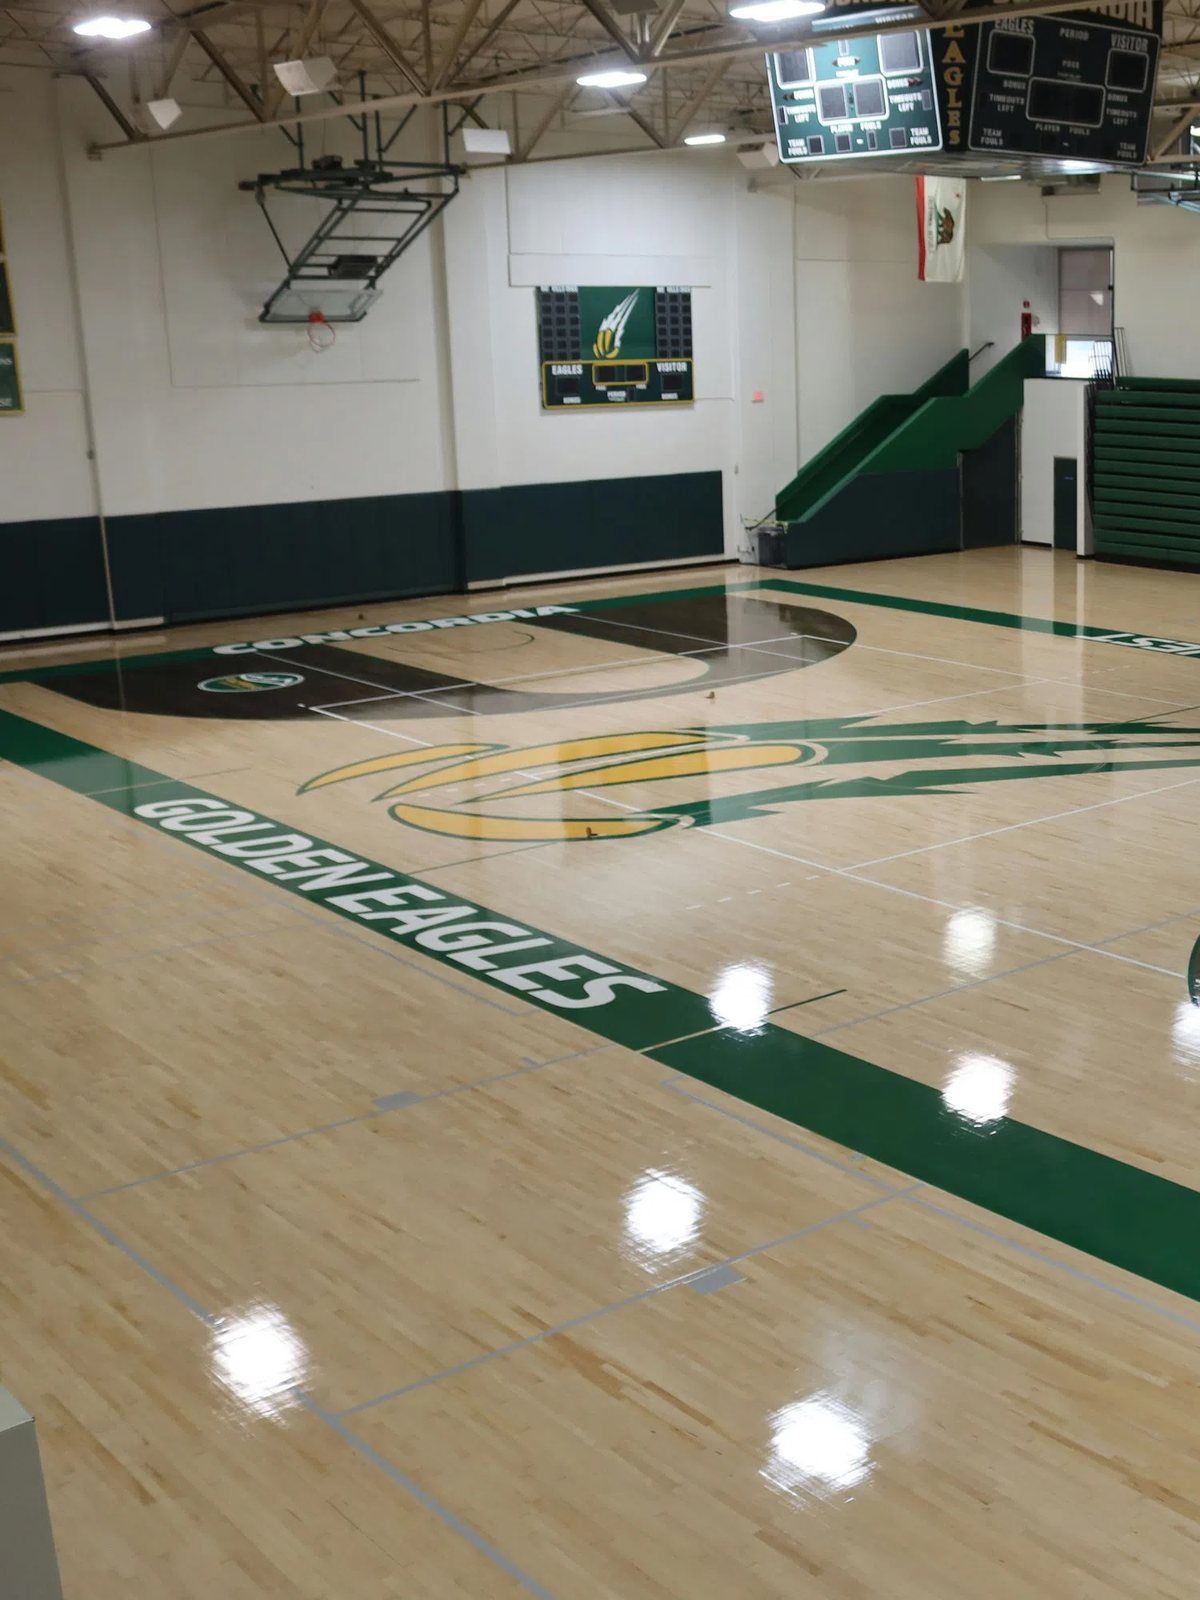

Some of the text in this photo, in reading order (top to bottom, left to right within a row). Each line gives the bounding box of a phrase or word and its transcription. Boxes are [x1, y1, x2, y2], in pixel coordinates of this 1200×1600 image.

[994, 16, 1035, 34] EAGLES
[1060, 28, 1090, 41] PERIOD
[1111, 34, 1149, 50] VISITOR
[989, 93, 1025, 105] TIMEOUTS
[910, 127, 929, 136] TEAM
[983, 128, 1002, 137] TEAM
[1035, 123, 1090, 136] PLAYER FOULS
[910, 135, 932, 145] FOULS
[980, 136, 1003, 146] FOULS
[552, 364, 583, 375] EAGLES
[656, 362, 687, 372] VISITOR
[213, 605, 581, 655] CONCORDIA
[133, 798, 668, 1009] GOLDEN EAGLES
